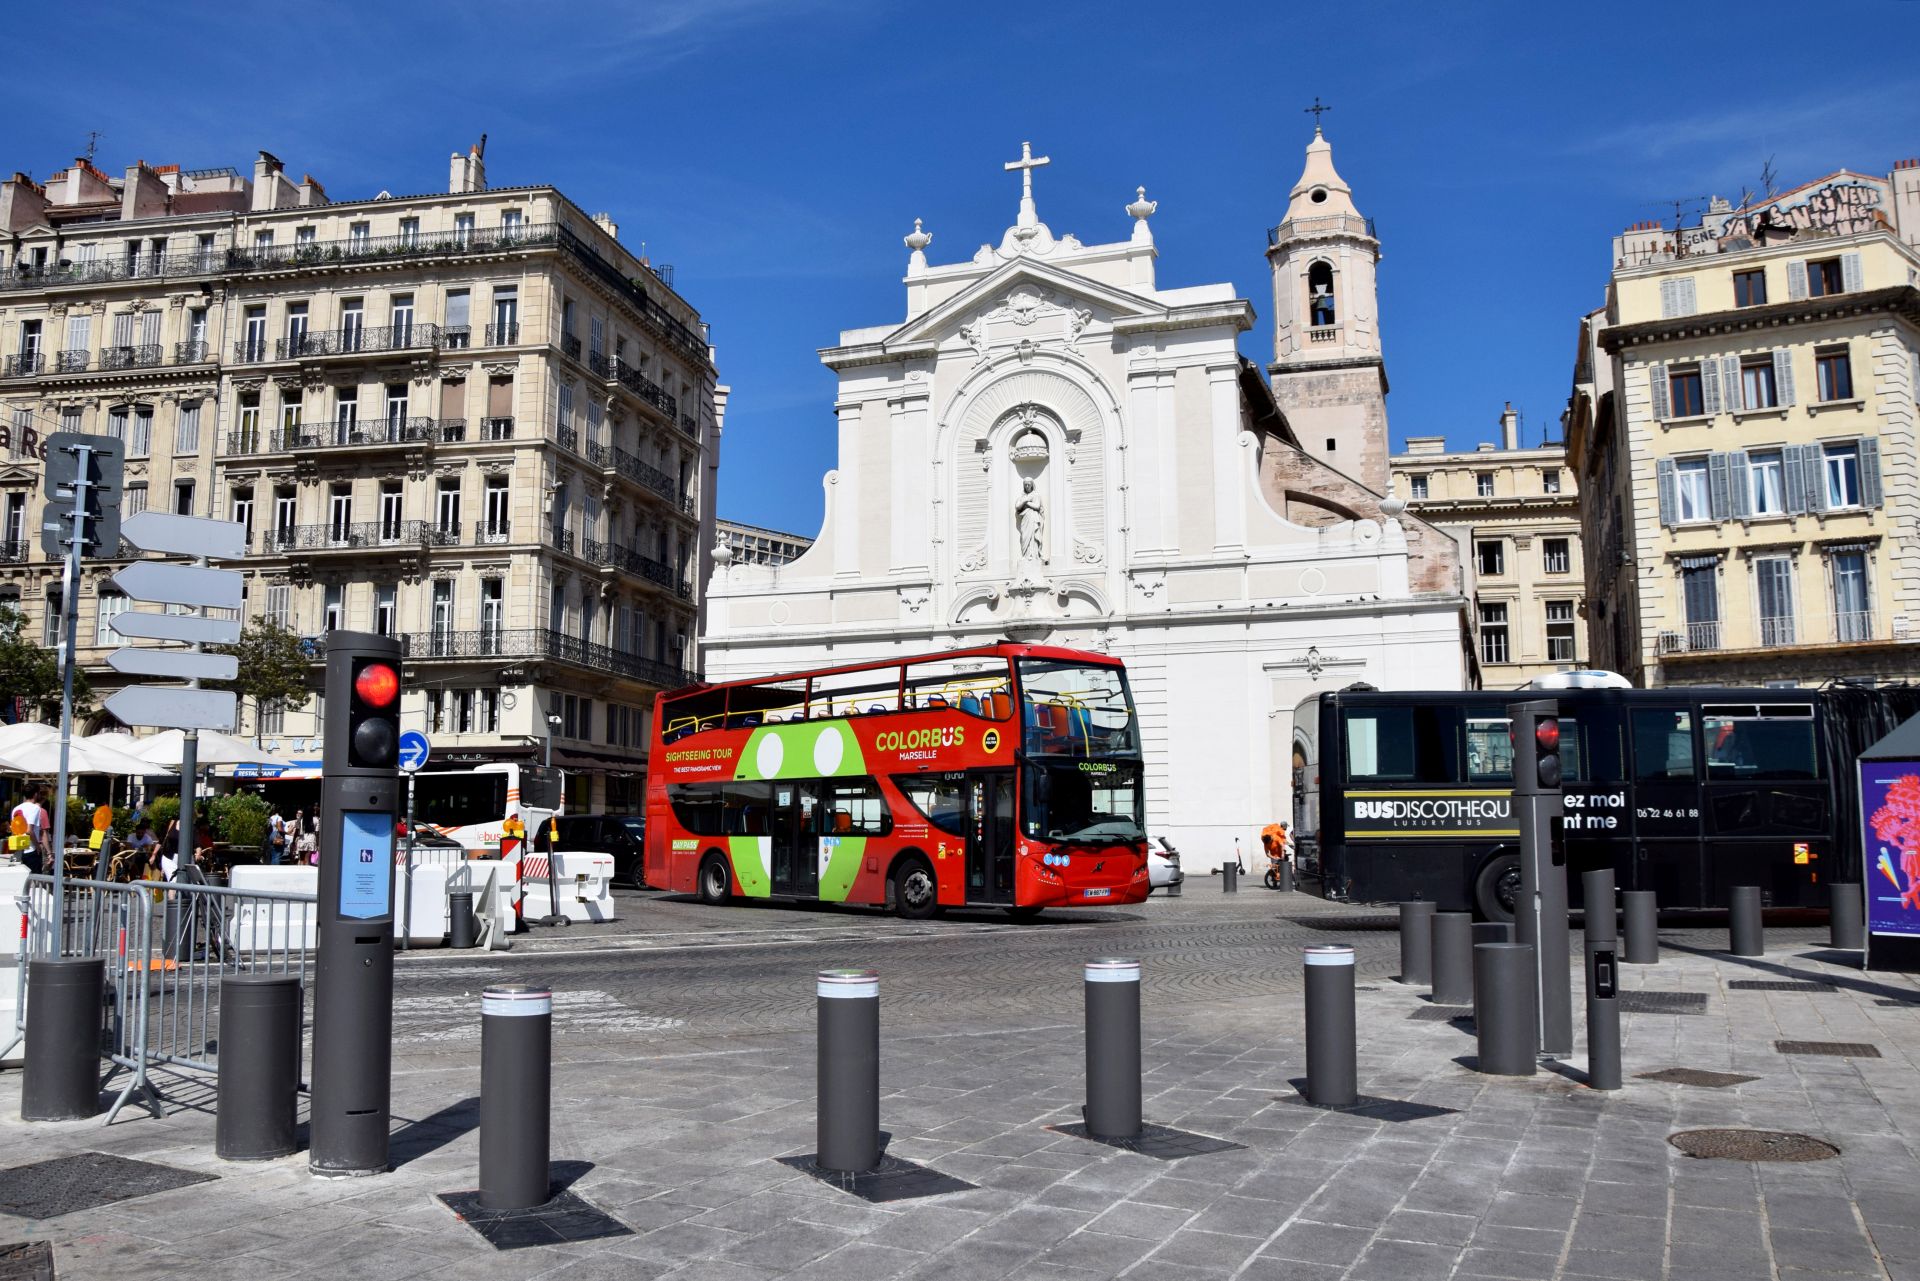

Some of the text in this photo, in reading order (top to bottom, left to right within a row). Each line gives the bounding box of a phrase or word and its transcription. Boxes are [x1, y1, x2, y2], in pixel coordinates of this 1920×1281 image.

[665, 748, 733, 762] SIGHTSEEING TOUR
[899, 750, 937, 761] MARSEILLE
[1563, 791, 1625, 808] ez moi
[1651, 809, 1660, 818] 22
[1663, 809, 1673, 818] 46
[1676, 808, 1685, 818] 61
[1688, 808, 1699, 818] 88
[1563, 813, 1618, 829] nt me
